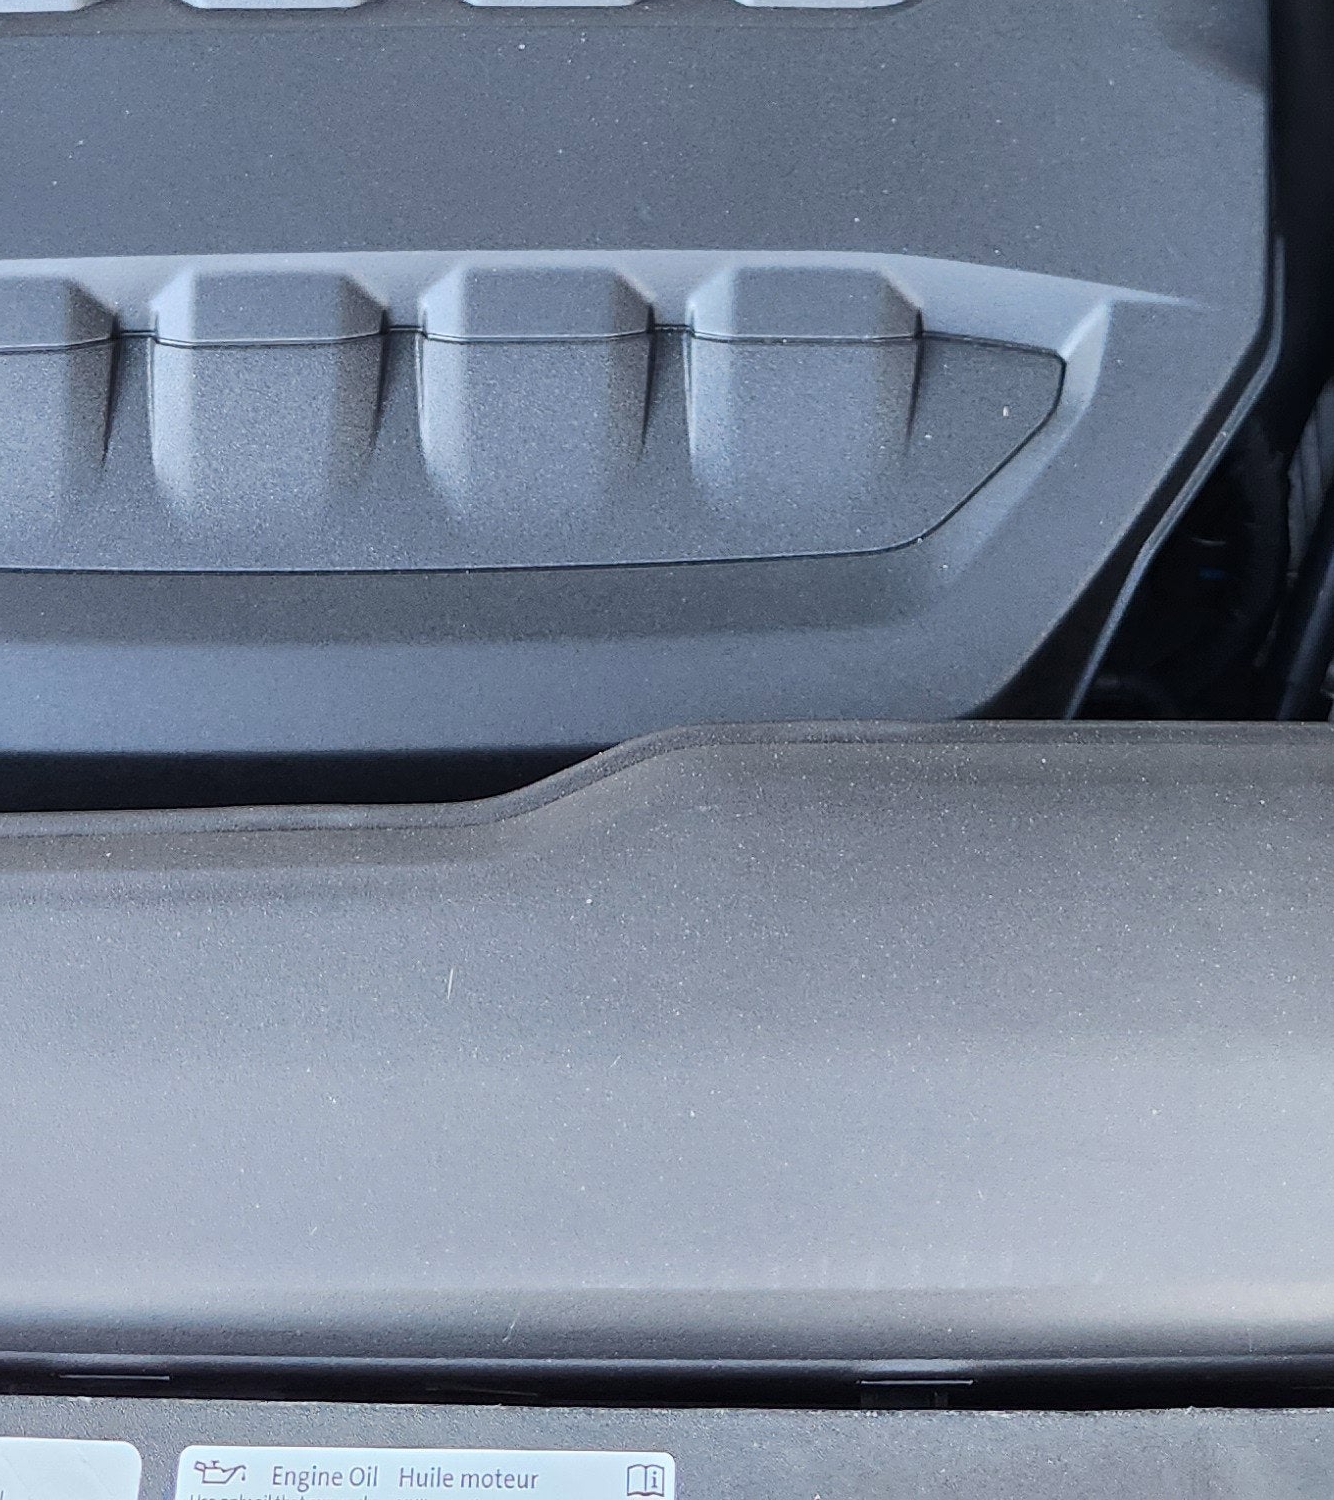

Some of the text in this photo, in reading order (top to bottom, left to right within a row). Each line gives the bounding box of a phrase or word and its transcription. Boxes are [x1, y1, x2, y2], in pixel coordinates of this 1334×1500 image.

[271, 1465, 540, 1493] Engine Oil Huile moteur
